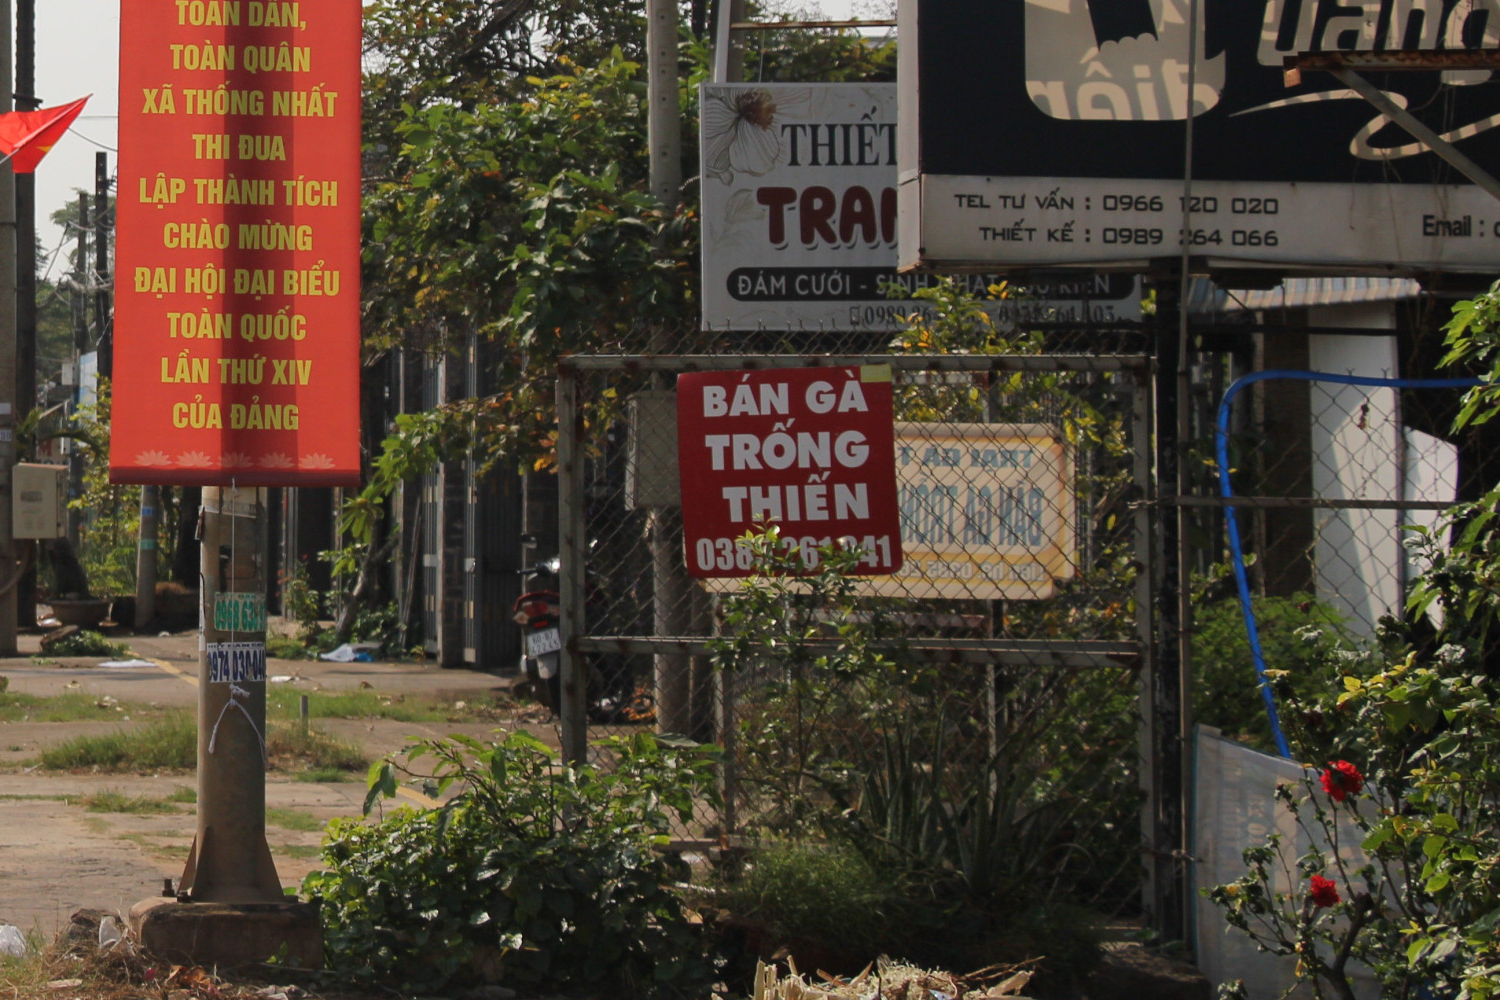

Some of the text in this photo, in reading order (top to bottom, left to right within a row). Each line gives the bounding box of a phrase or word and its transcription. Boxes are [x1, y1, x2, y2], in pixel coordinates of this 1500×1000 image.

[170, 39, 311, 74] TOÀN QUÂN
[142, 80, 338, 117] XÃ THỐNG NHẤT
[193, 133, 286, 161] THI ĐUA
[781, 106, 897, 167] THIẾT
[140, 173, 338, 209] LẬP THÀNH TÍCH
[954, 193, 990, 208] TEL
[999, 193, 1026, 210] TƯ
[1035, 188, 1074, 210] VẤN
[1103, 194, 1164, 212] 0966
[1179, 196, 1218, 213] 120
[1232, 197, 1279, 215] 020
[163, 218, 313, 251] CHÀO MỪNG
[979, 219, 1037, 241] THIẾT
[1047, 220, 1074, 242] KẾ
[1103, 227, 1164, 244] 0989
[1232, 230, 1279, 246] 066
[1423, 214, 1472, 237] Email
[134, 259, 340, 302] ĐẠI HỘI ĐẠI BIỂU
[737, 269, 787, 296] ĐÁM
[795, 269, 850, 296] CƯỚI
[876, 273, 929, 296] SINH
[167, 305, 307, 343] TOÀN QUỐC
[161, 348, 312, 386] LẦN THỨ XIV
[703, 369, 869, 418] BÁN GÀ
[172, 394, 299, 431] CỦA ĐẢNG
[705, 418, 870, 471] TRỐNG
[722, 471, 870, 523] THIẾN
